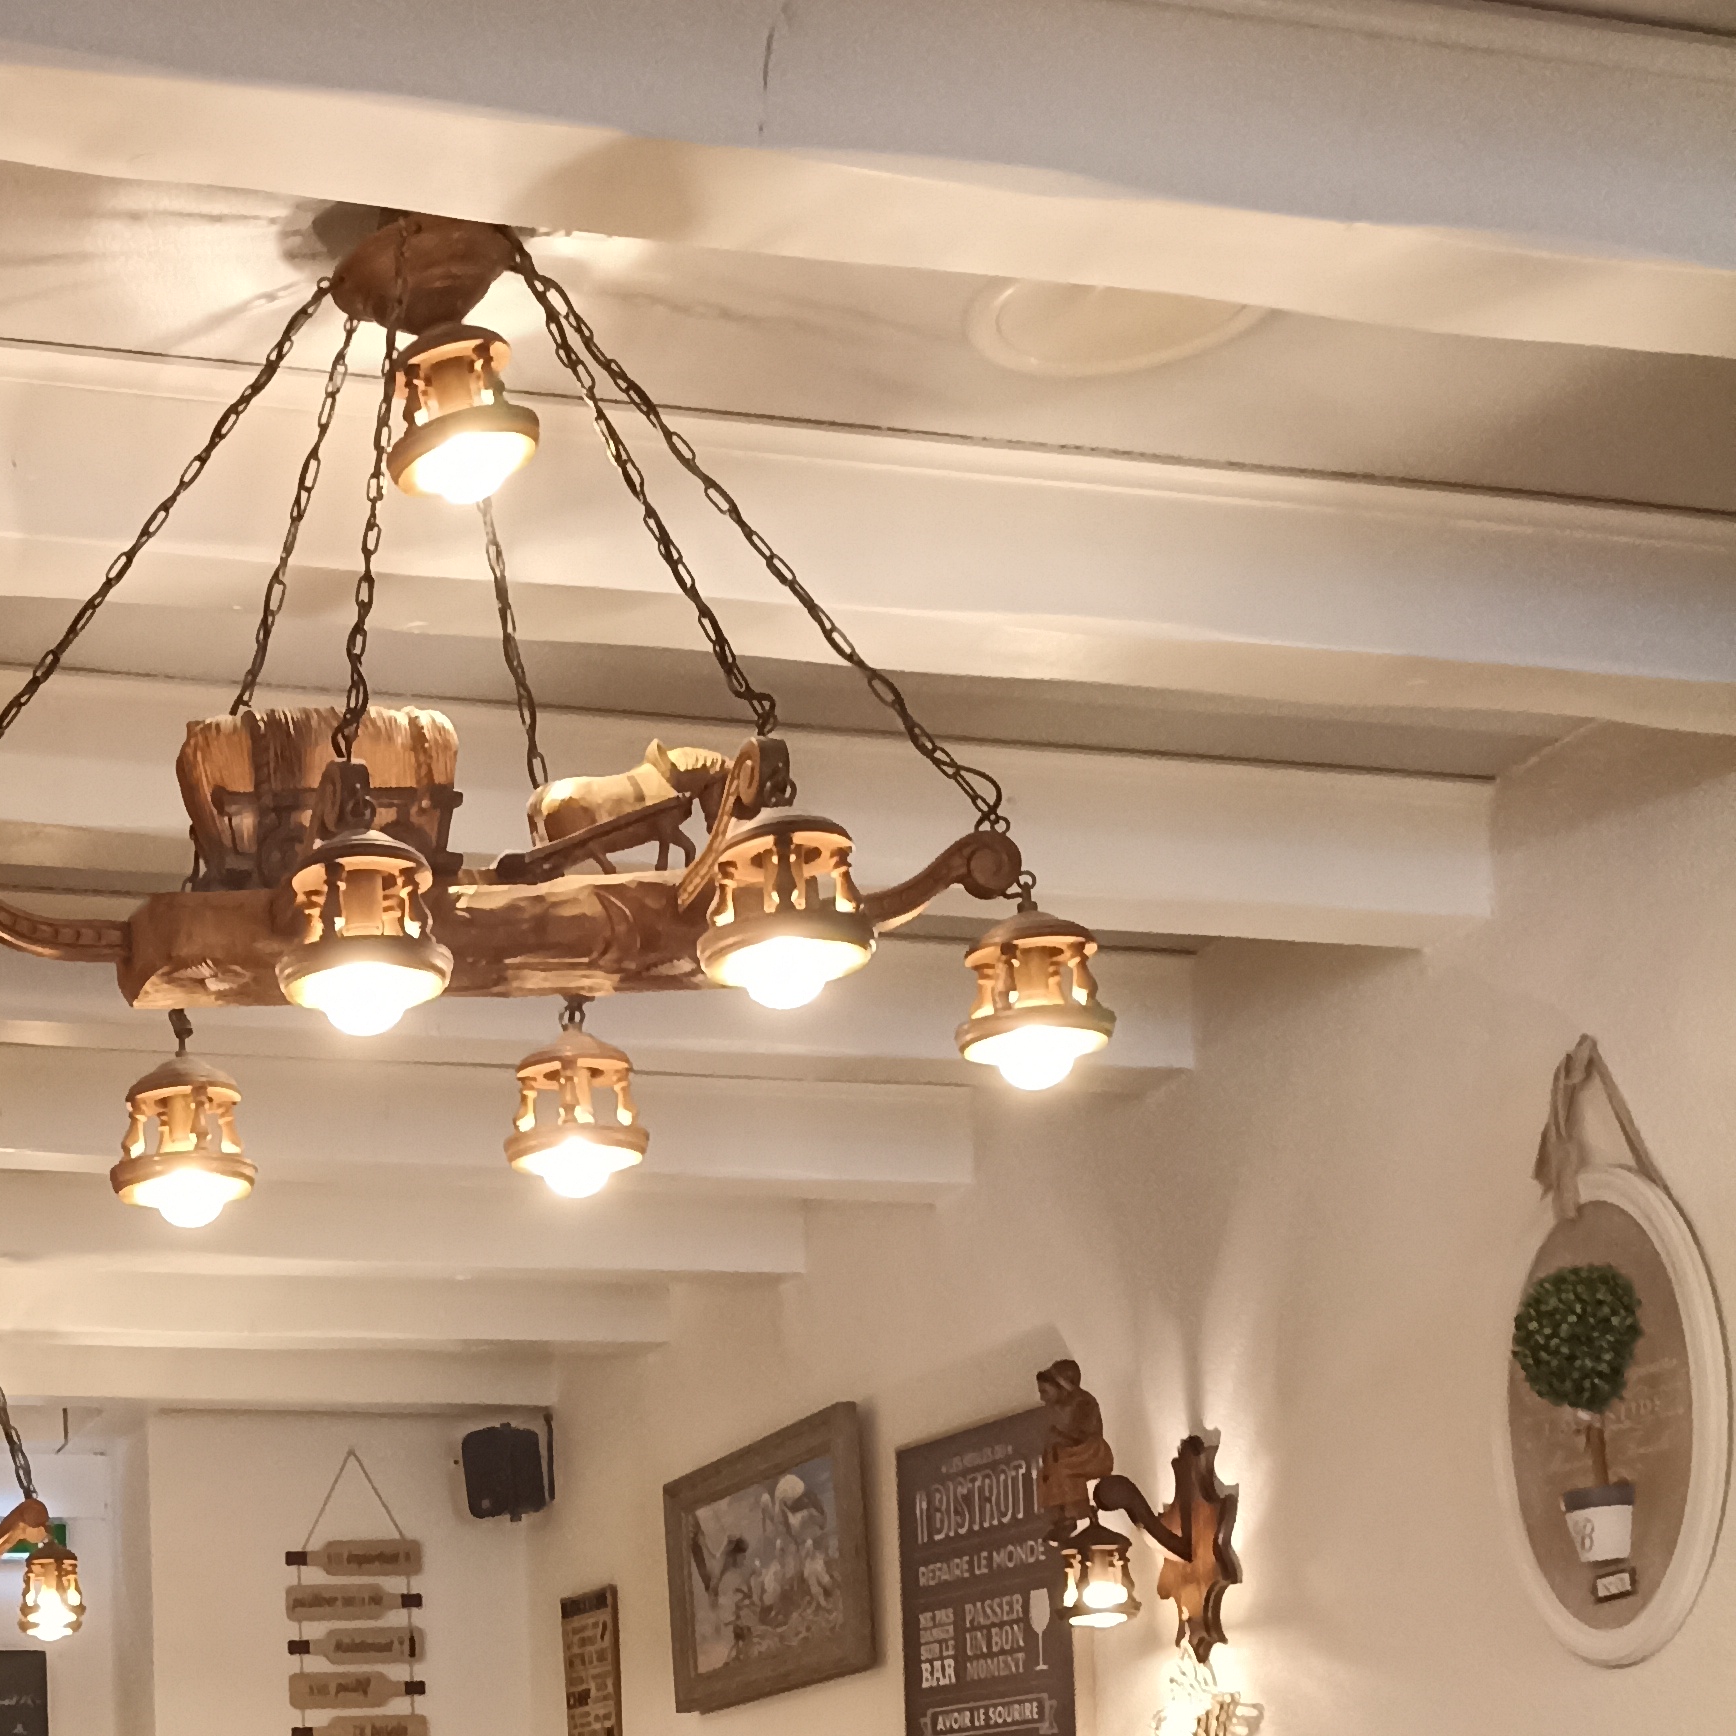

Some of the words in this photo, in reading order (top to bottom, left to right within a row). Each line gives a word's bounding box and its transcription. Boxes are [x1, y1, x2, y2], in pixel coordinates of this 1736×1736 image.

[930, 1459, 1026, 1541] BISTROT
[919, 1556, 970, 1587] REFAIRE
[974, 1551, 989, 1575] LE
[993, 1539, 1046, 1569] MONDE
[965, 1594, 1023, 1628] PASSER
[966, 1629, 988, 1656] UN
[991, 1622, 1025, 1653] BON
[921, 1659, 956, 1689] BAR
[966, 1652, 1026, 1681] MOMENT
[937, 1710, 971, 1731] AVOIR
[974, 1708, 985, 1726] LE
[989, 1701, 1039, 1725] SOURIRE
